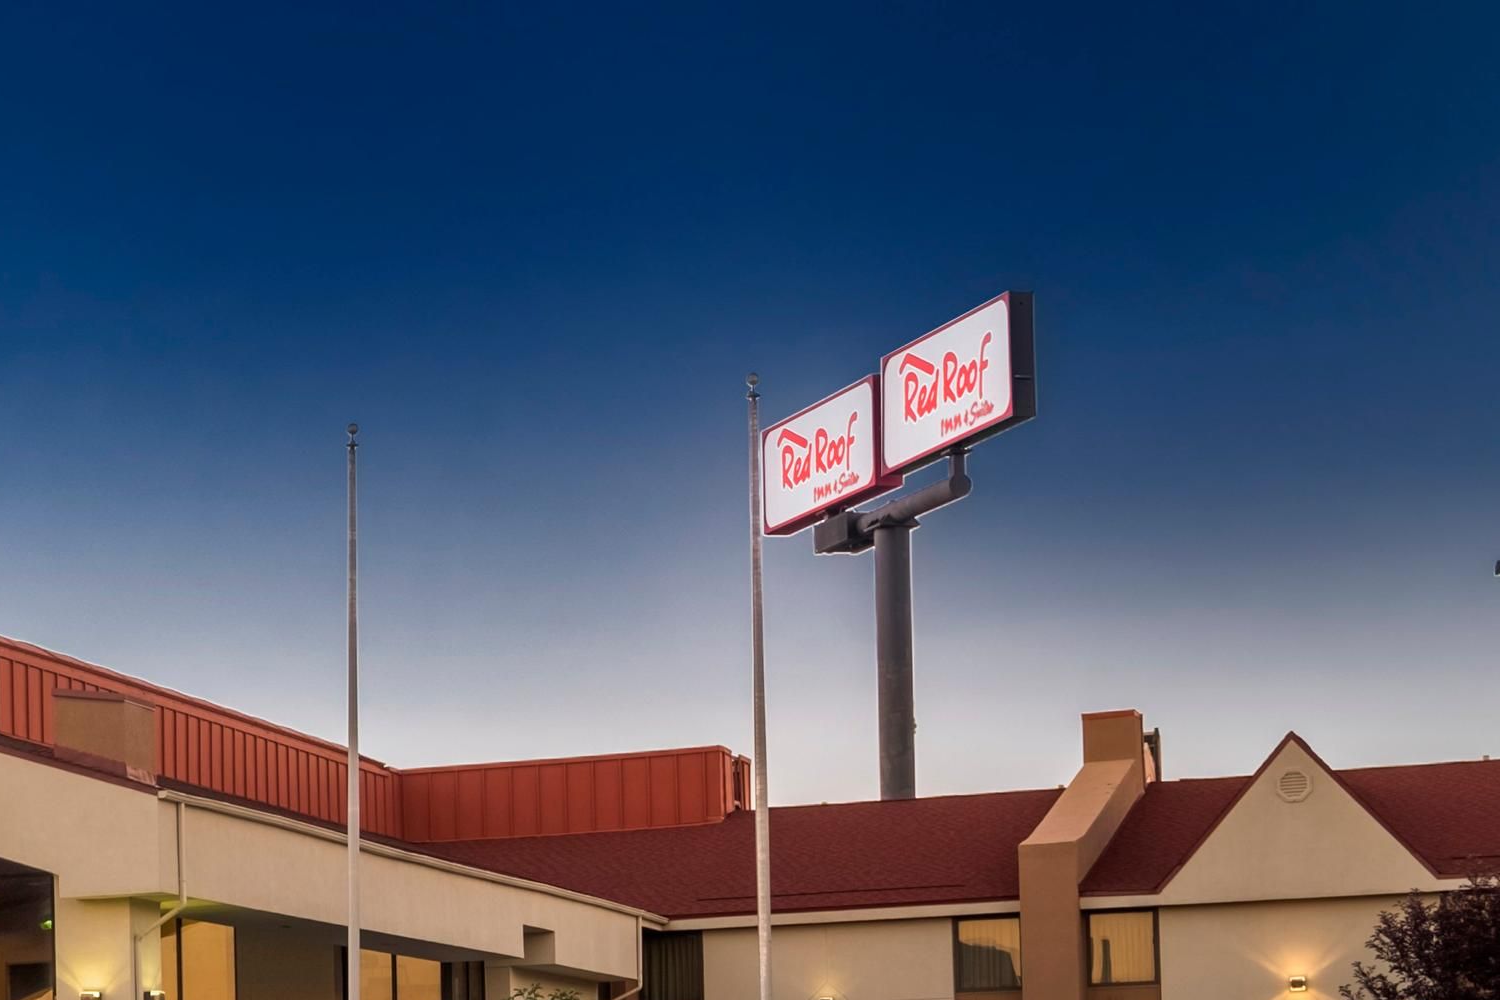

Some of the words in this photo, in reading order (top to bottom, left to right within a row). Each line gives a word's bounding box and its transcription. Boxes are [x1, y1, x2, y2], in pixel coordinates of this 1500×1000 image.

[904, 368, 940, 423] Red
[943, 331, 992, 403] Roof
[781, 442, 812, 490] Red
[815, 411, 858, 473] Roof
